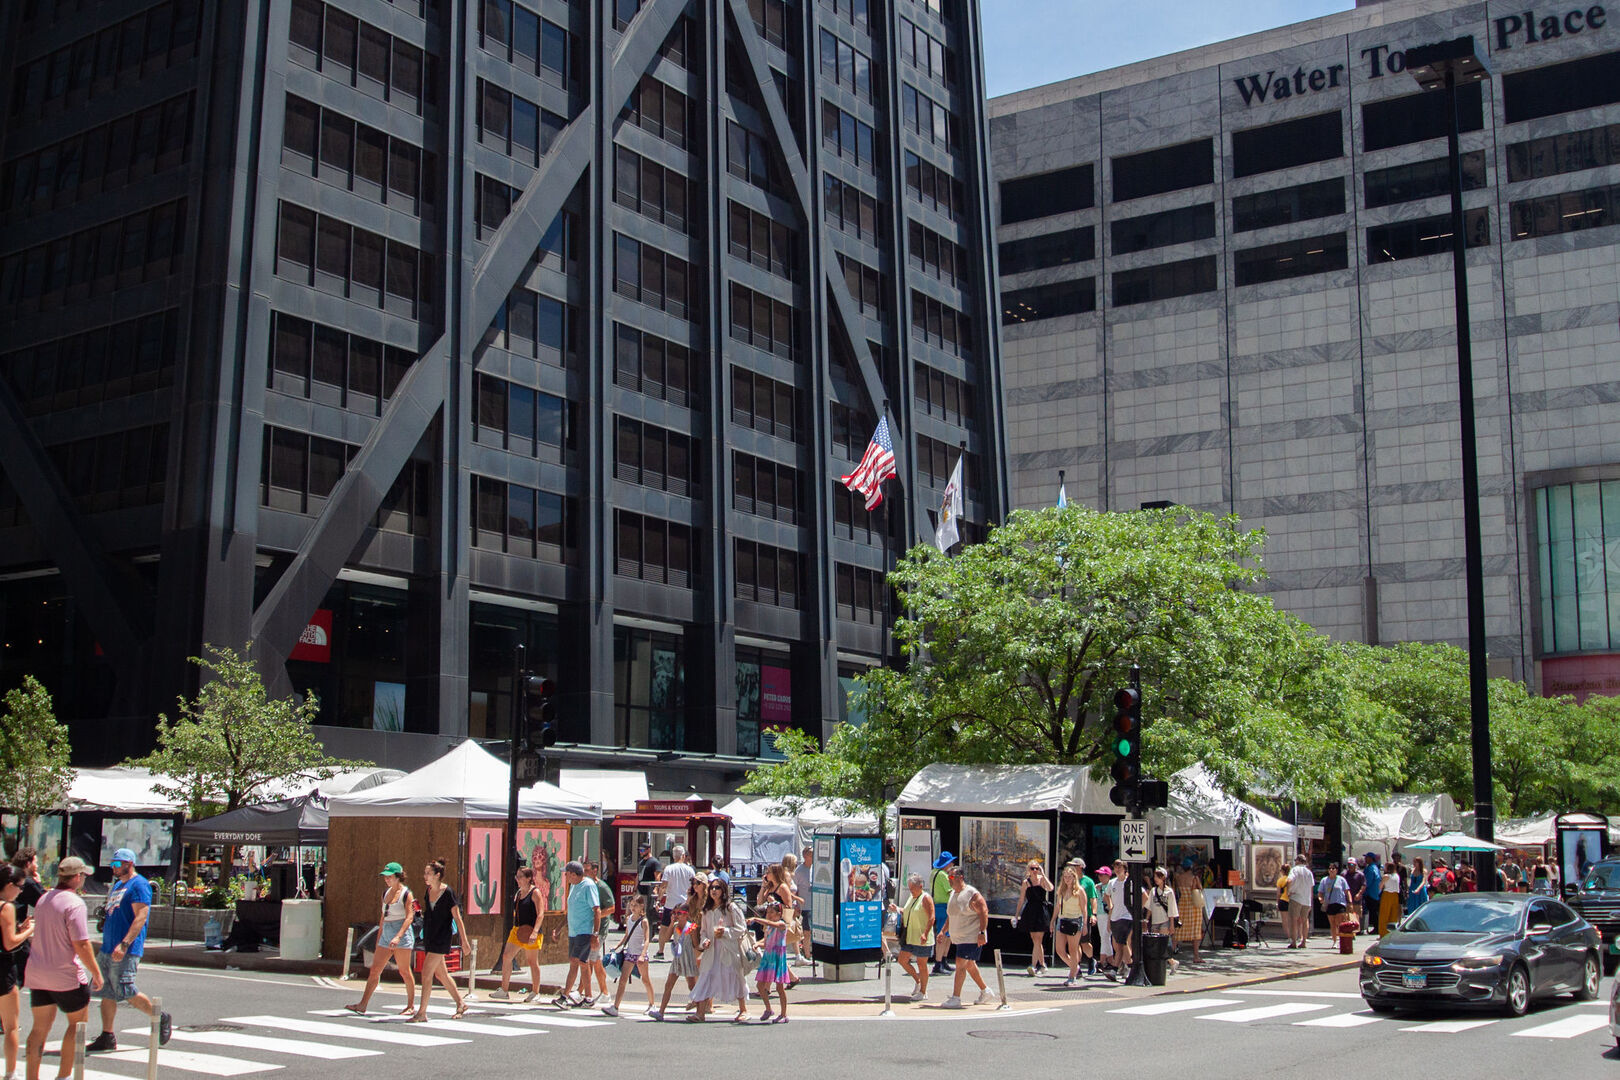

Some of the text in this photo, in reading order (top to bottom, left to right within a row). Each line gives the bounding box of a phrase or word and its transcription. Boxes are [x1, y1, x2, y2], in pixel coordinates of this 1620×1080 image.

[1233, 5, 1606, 106] Water Place
[299, 636, 317, 645] FACE
[1123, 824, 1144, 833] ONE
[214, 832, 244, 840] EVERYDAY
[1123, 835, 1144, 845] WAY
